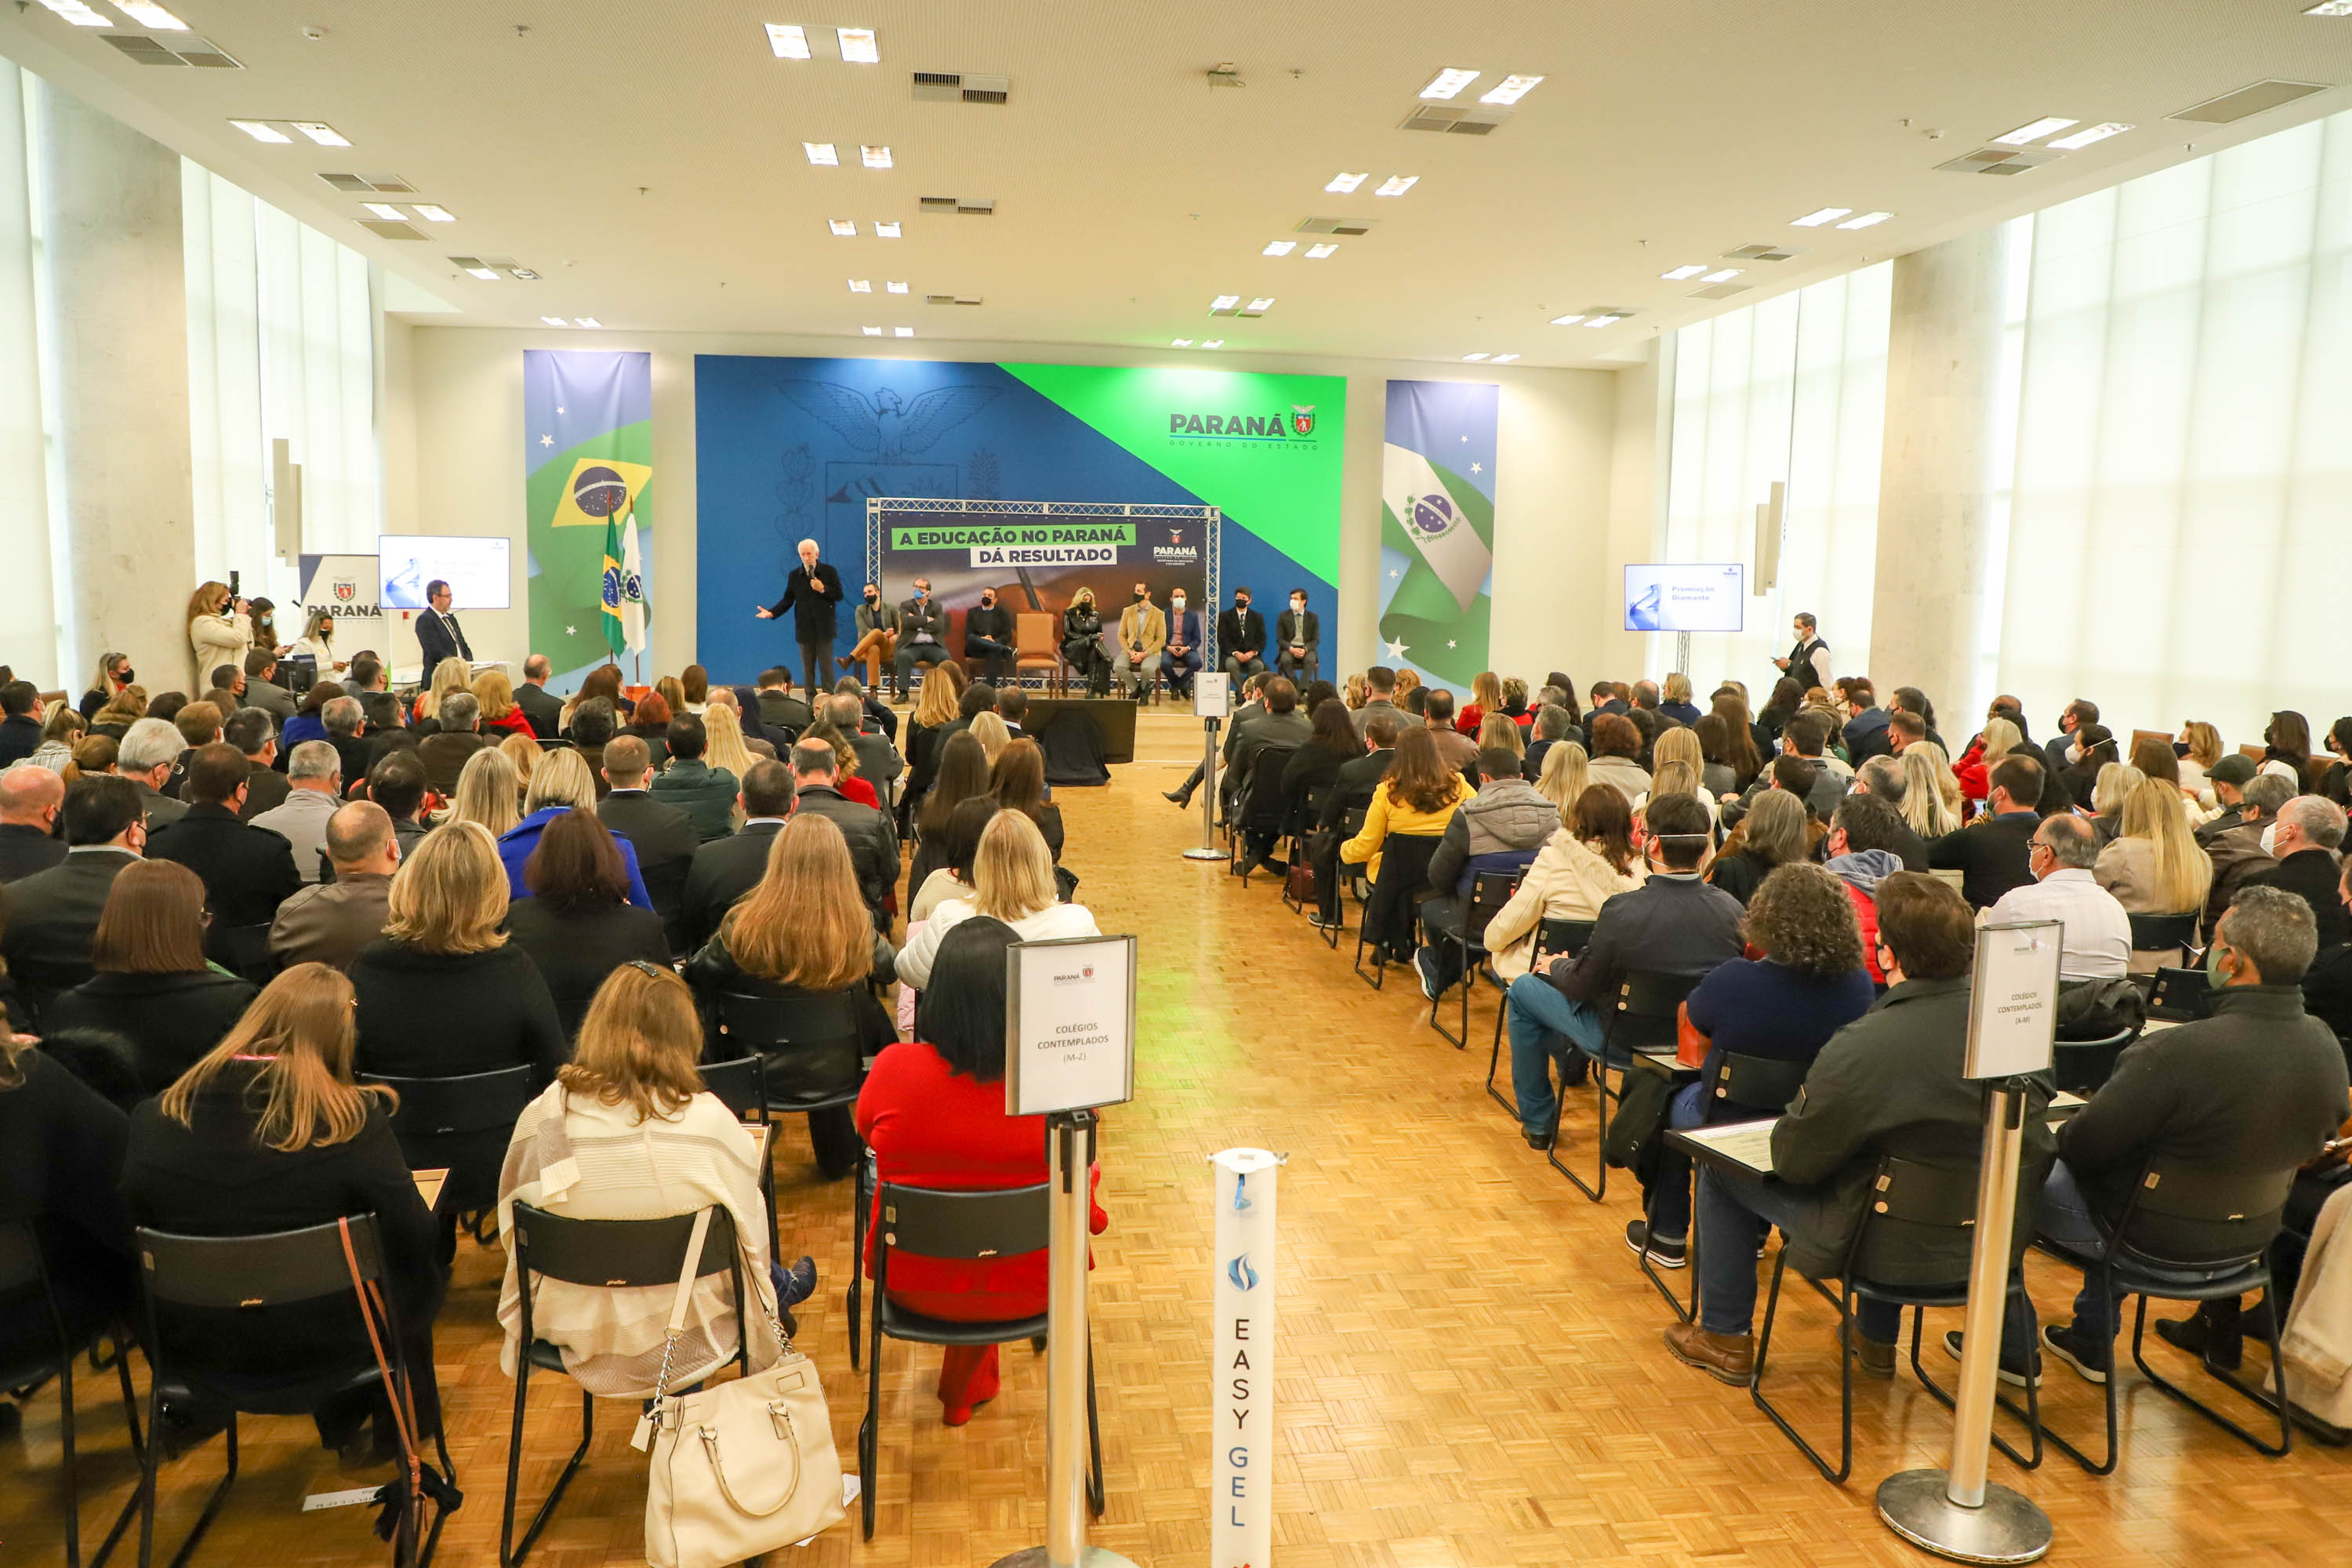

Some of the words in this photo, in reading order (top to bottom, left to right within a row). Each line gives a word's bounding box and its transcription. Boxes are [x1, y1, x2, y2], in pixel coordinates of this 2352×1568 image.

[1170, 413, 1287, 437] PARANÁ
[1169, 440, 1232, 448] GOVERNO
[900, 532, 913, 546] A
[917, 527, 1017, 546] EDUCAÇÃO
[1022, 530, 1047, 543] NO
[1052, 525, 1127, 543] PARANÁ
[979, 547, 1004, 563] DÁ
[1009, 548, 1112, 562] RESULTADO
[1153, 546, 1198, 556] PARANÁ
[2012, 992, 2038, 1000] COLÉGIOS
[1998, 1002, 2042, 1014] CONTEMPLADOS
[1055, 1022, 1098, 1034] COLÉGIOS
[1037, 1036, 1109, 1050] CONTEMPLADOS
[1062, 1052, 1087, 1063] (M-Z)
[1232, 1318, 1250, 1430] EASY
[1228, 1446, 1248, 1527] GEL
